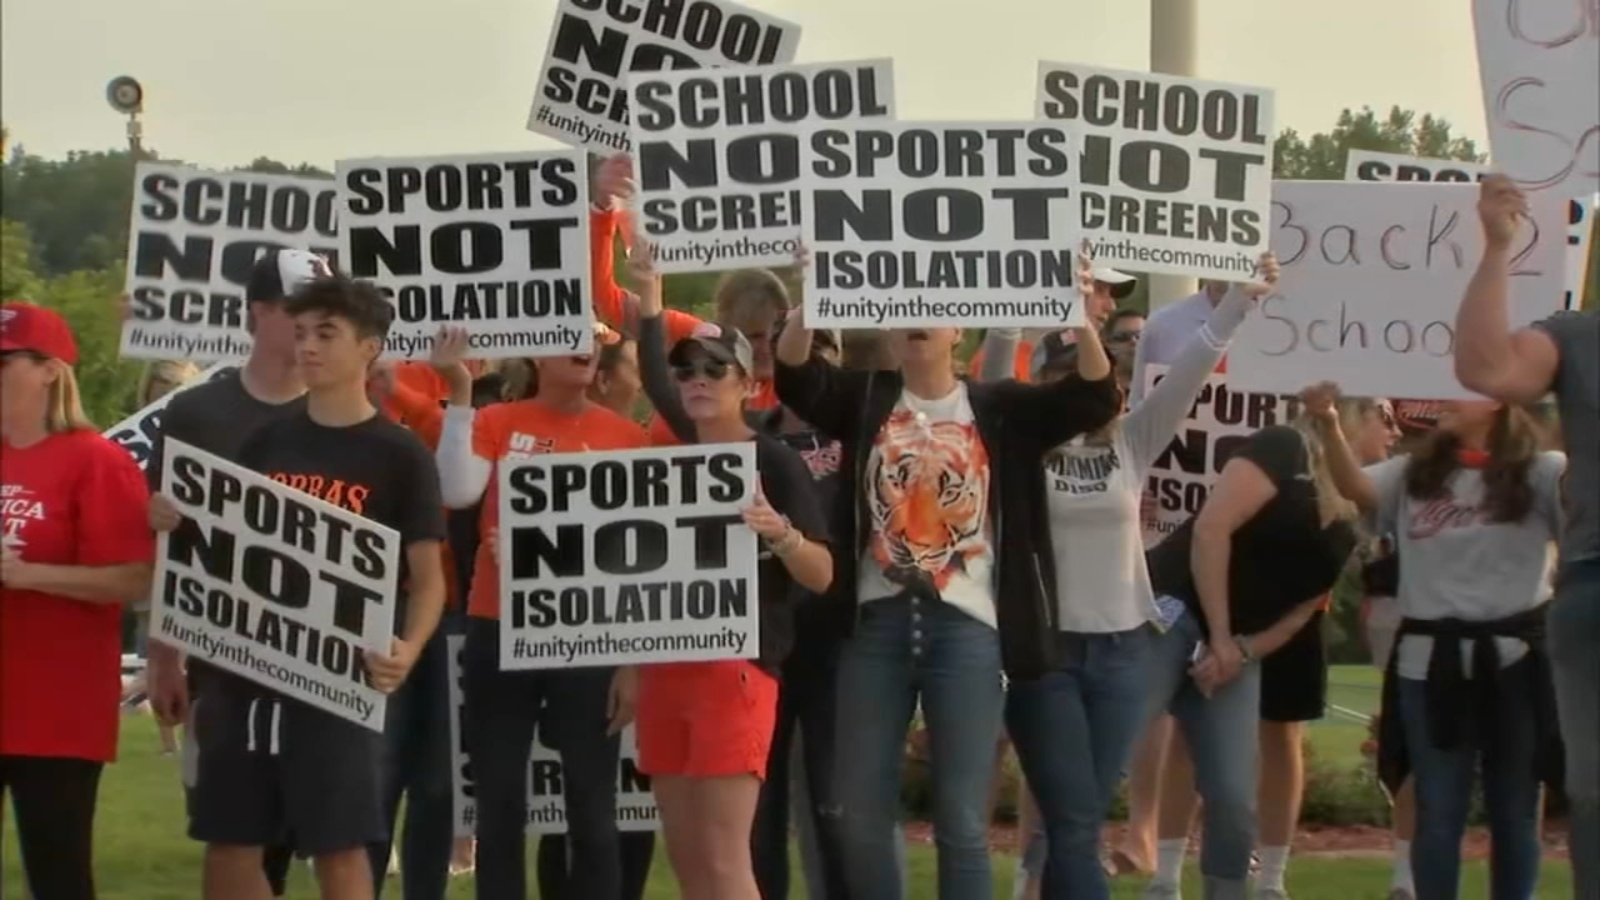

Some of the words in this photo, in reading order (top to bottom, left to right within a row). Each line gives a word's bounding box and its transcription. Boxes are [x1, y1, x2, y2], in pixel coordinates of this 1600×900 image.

[635, 67, 887, 131] SCHOOL
[1044, 70, 1266, 145] SCHOOL
[536, 105, 634, 153] #unityinth
[811, 128, 1067, 179] SPORTS
[346, 158, 577, 215] SPORTS
[639, 133, 800, 192] NO
[142, 173, 337, 238] SCHOO
[643, 190, 800, 236] SCRE
[814, 187, 1068, 242] NOT
[1081, 191, 1260, 246] CREENS
[350, 217, 578, 277] NOT
[649, 237, 800, 266] #unityintheco
[1087, 238, 1259, 279] yinthecommunity
[1271, 200, 1464, 271] Back
[816, 249, 1072, 290] ISOLATION
[817, 296, 1072, 323] #unityinthecommunity
[1257, 294, 1454, 356] Schoo
[129, 332, 250, 357] #unityinthe
[510, 453, 744, 515] SPORTS
[172, 455, 386, 580] SPORTS
[512, 515, 743, 580] NOT
[168, 517, 383, 637] NOT
[512, 578, 747, 629] ISOLATION
[161, 614, 374, 721] #unityinthecommunity
[513, 628, 747, 663] #unityinthecommunity
